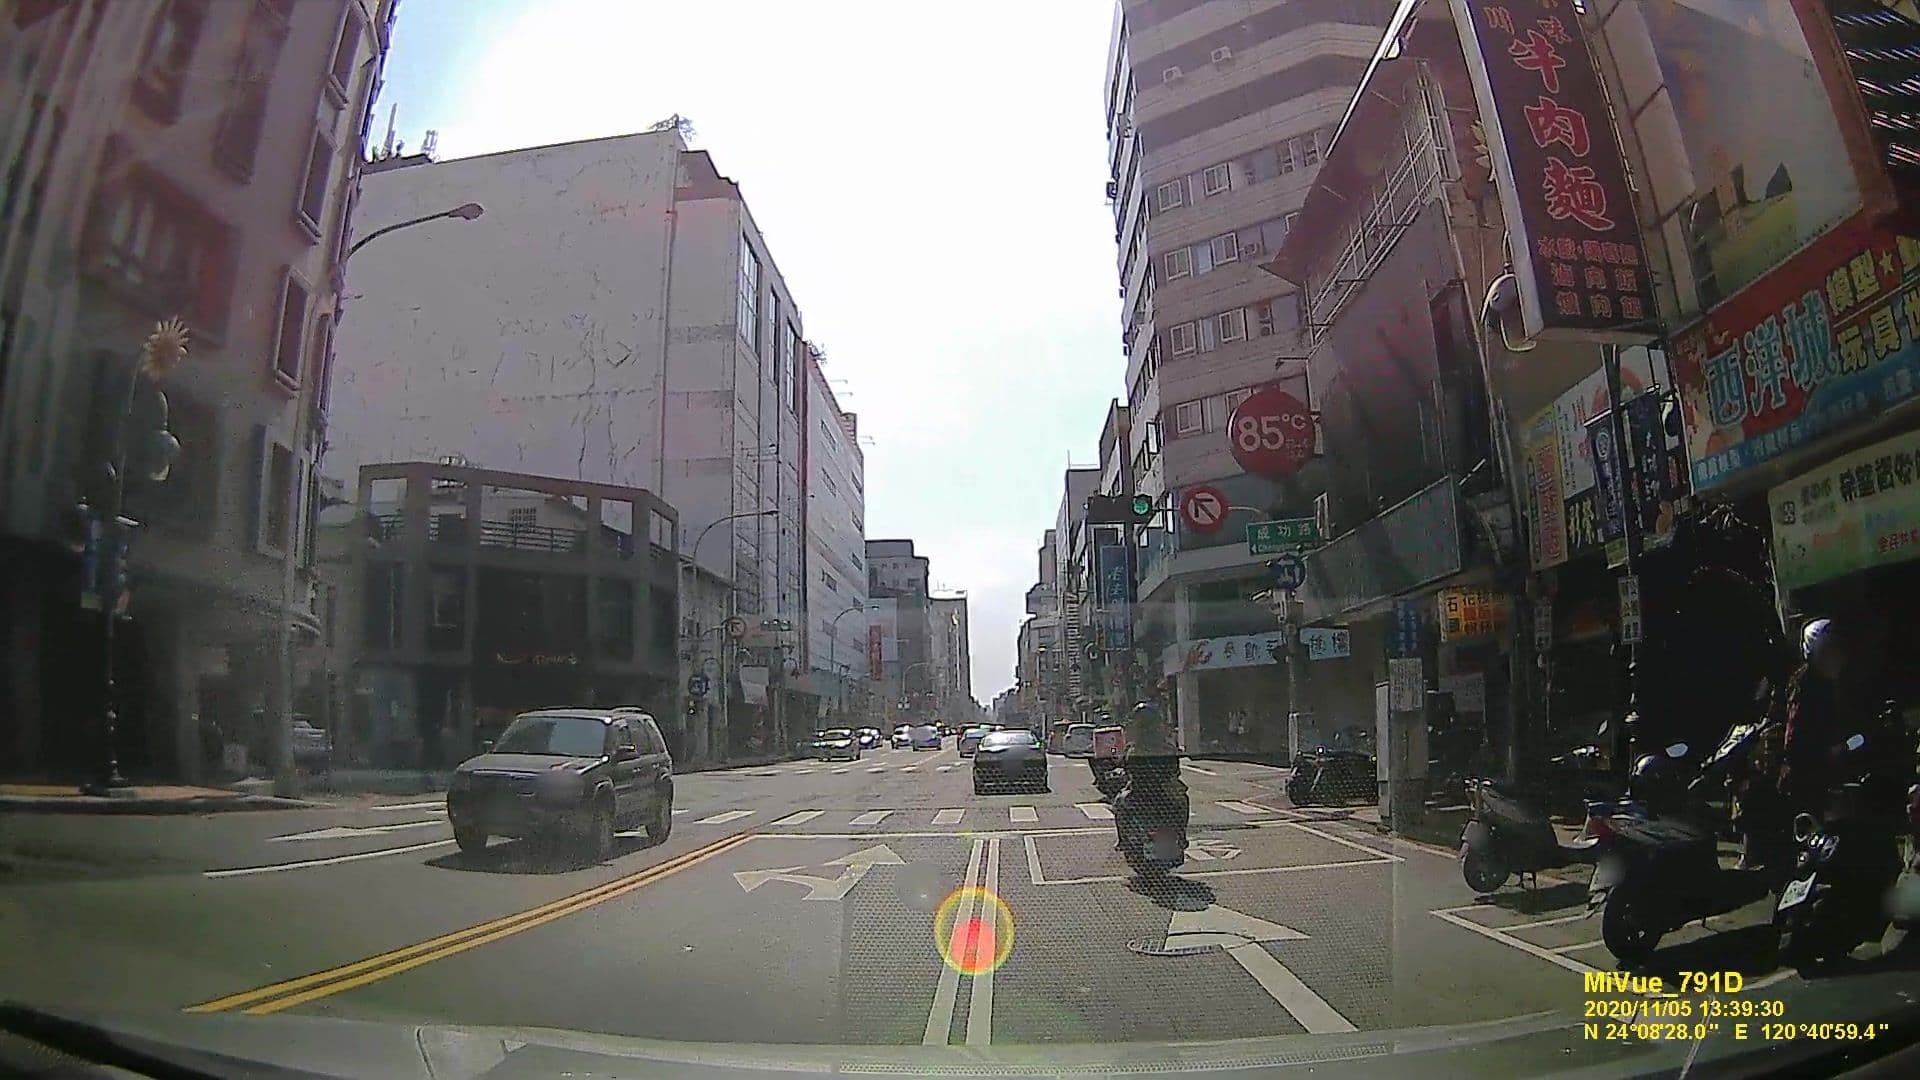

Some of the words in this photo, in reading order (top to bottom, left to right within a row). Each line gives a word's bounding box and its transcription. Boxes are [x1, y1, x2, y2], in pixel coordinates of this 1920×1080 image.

[1507, 28, 1616, 232] 牛肉麵
[1704, 289, 1838, 427] 西洋城
[1257, 523, 1312, 540] 成功路
